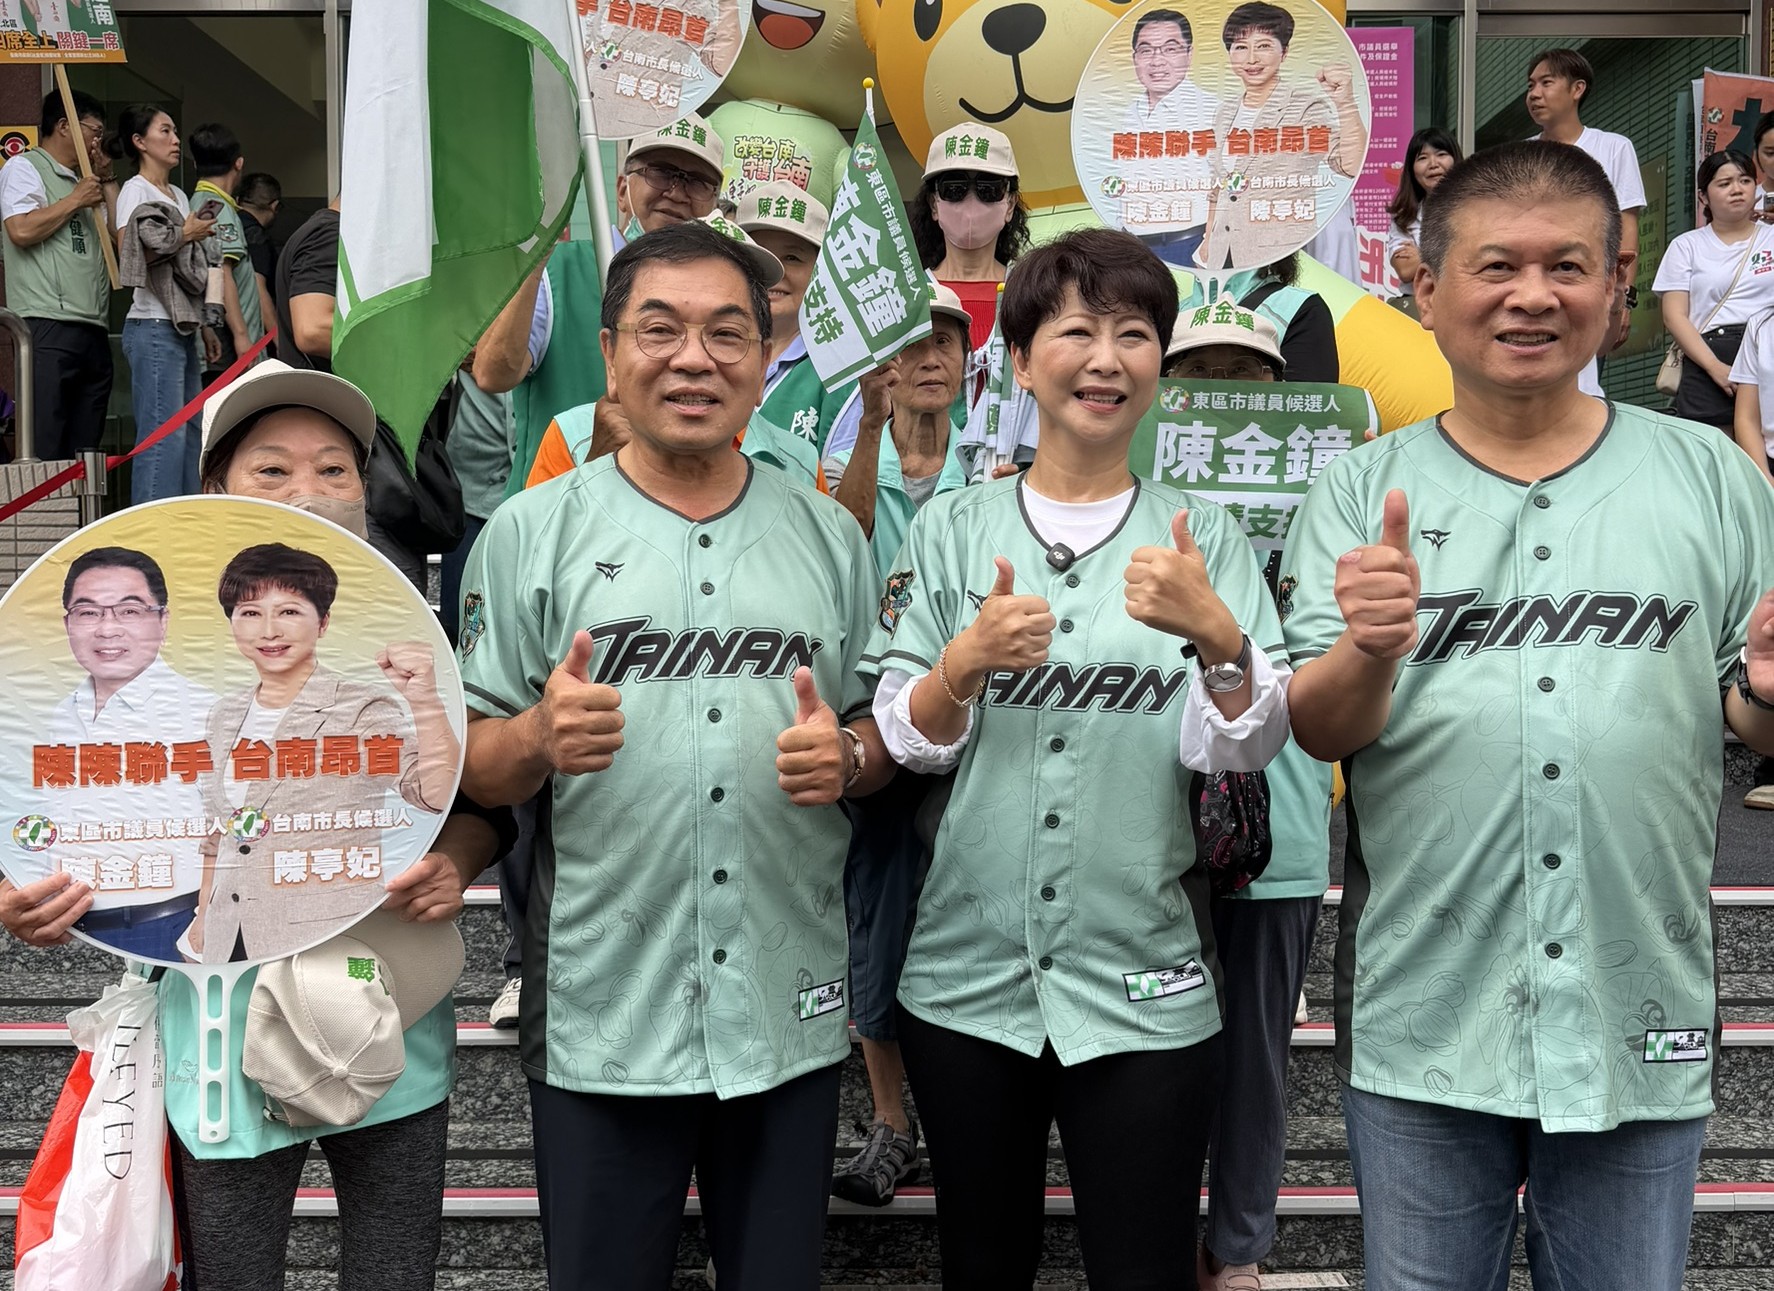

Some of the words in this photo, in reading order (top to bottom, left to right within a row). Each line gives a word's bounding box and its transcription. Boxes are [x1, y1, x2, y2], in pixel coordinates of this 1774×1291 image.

[92, 0, 114, 25] 南
[608, 0, 710, 45] 台南昂首
[56, 30, 120, 50] 關鍵一席
[622, 49, 704, 80] 台南市長候選人
[616, 72, 682, 107] 陳亭妃
[944, 133, 990, 161] 陳金鐘
[1112, 129, 1217, 160] 陳陳聯手
[1227, 125, 1332, 155] 台南昂首
[1705, 128, 1718, 157] 台南
[1126, 176, 1224, 194] 東區市議員候選人
[1250, 173, 1336, 189] 台南市長候選人
[757, 195, 808, 223] 陳金鐘
[1126, 200, 1192, 224] 陳金鐘
[1250, 200, 1316, 222] 陳亭妃
[70, 213, 87, 254] 健順
[865, 168, 922, 301] 東區市議員候選人
[804, 264, 845, 345] 支持
[1190, 300, 1254, 331] 陳金鐘
[1192, 392, 1341, 413] 東區市議員候選人
[790, 406, 819, 441] 陳
[1152, 420, 1352, 485] 陳金鐘
[1405, 587, 1698, 667] TAINAN
[586, 615, 825, 687] TAINAN
[977, 660, 1187, 716] AINAN
[32, 739, 214, 789] 陳陳聯手
[230, 734, 405, 781] 台南昂首
[59, 813, 228, 843] 東區市議員候選人
[272, 806, 413, 834] 台南市長候選人
[272, 846, 382, 885] 陳亭妃
